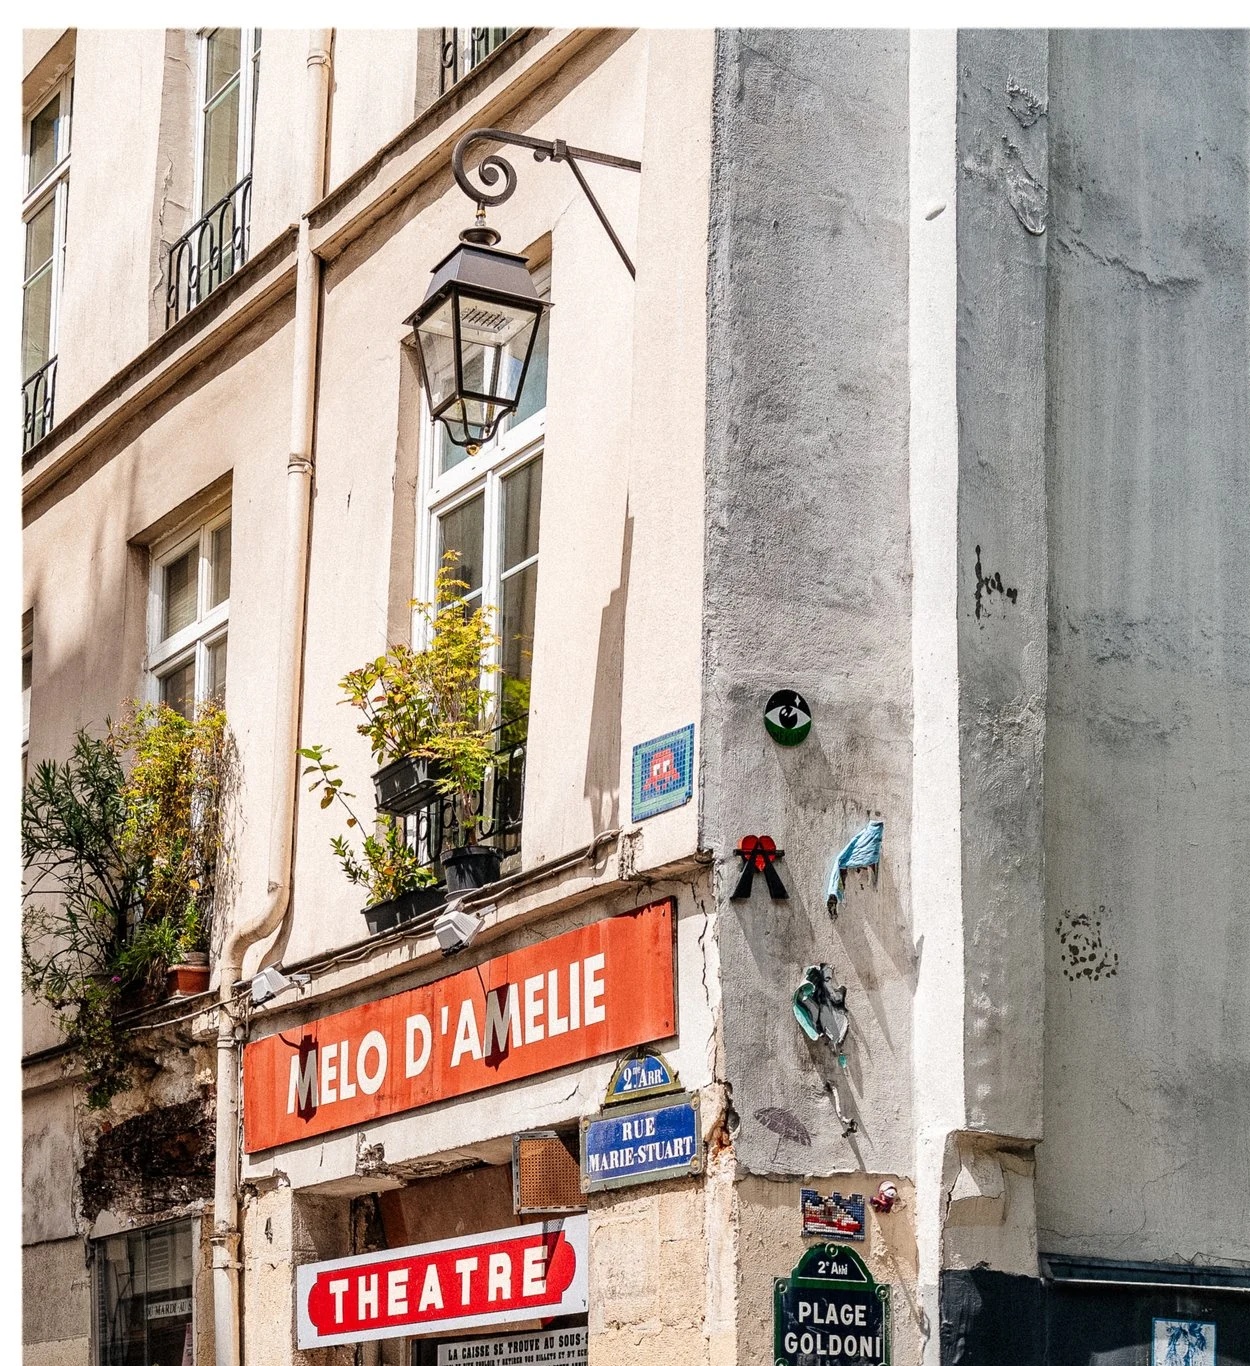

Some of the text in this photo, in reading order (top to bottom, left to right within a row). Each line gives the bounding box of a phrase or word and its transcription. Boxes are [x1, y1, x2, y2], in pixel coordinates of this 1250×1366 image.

[287, 1030, 388, 1114] MELO
[622, 1117, 655, 1140] RUE
[589, 1136, 693, 1173] MARIE-STUART
[329, 1245, 548, 1324] THEATRE
[798, 1301, 867, 1326] PLAGE
[448, 1349, 458, 1361] LA
[462, 1344, 490, 1359] CAISSE
[494, 1343, 504, 1356] SE
[508, 1338, 540, 1355] TROUVE
[544, 1336, 555, 1350] AU
[784, 1332, 880, 1358] GOLDONI
[502, 1356, 523, 1365] RETIRER
[525, 1355, 534, 1363] VOS
[536, 1352, 556, 1362] BILLETS
